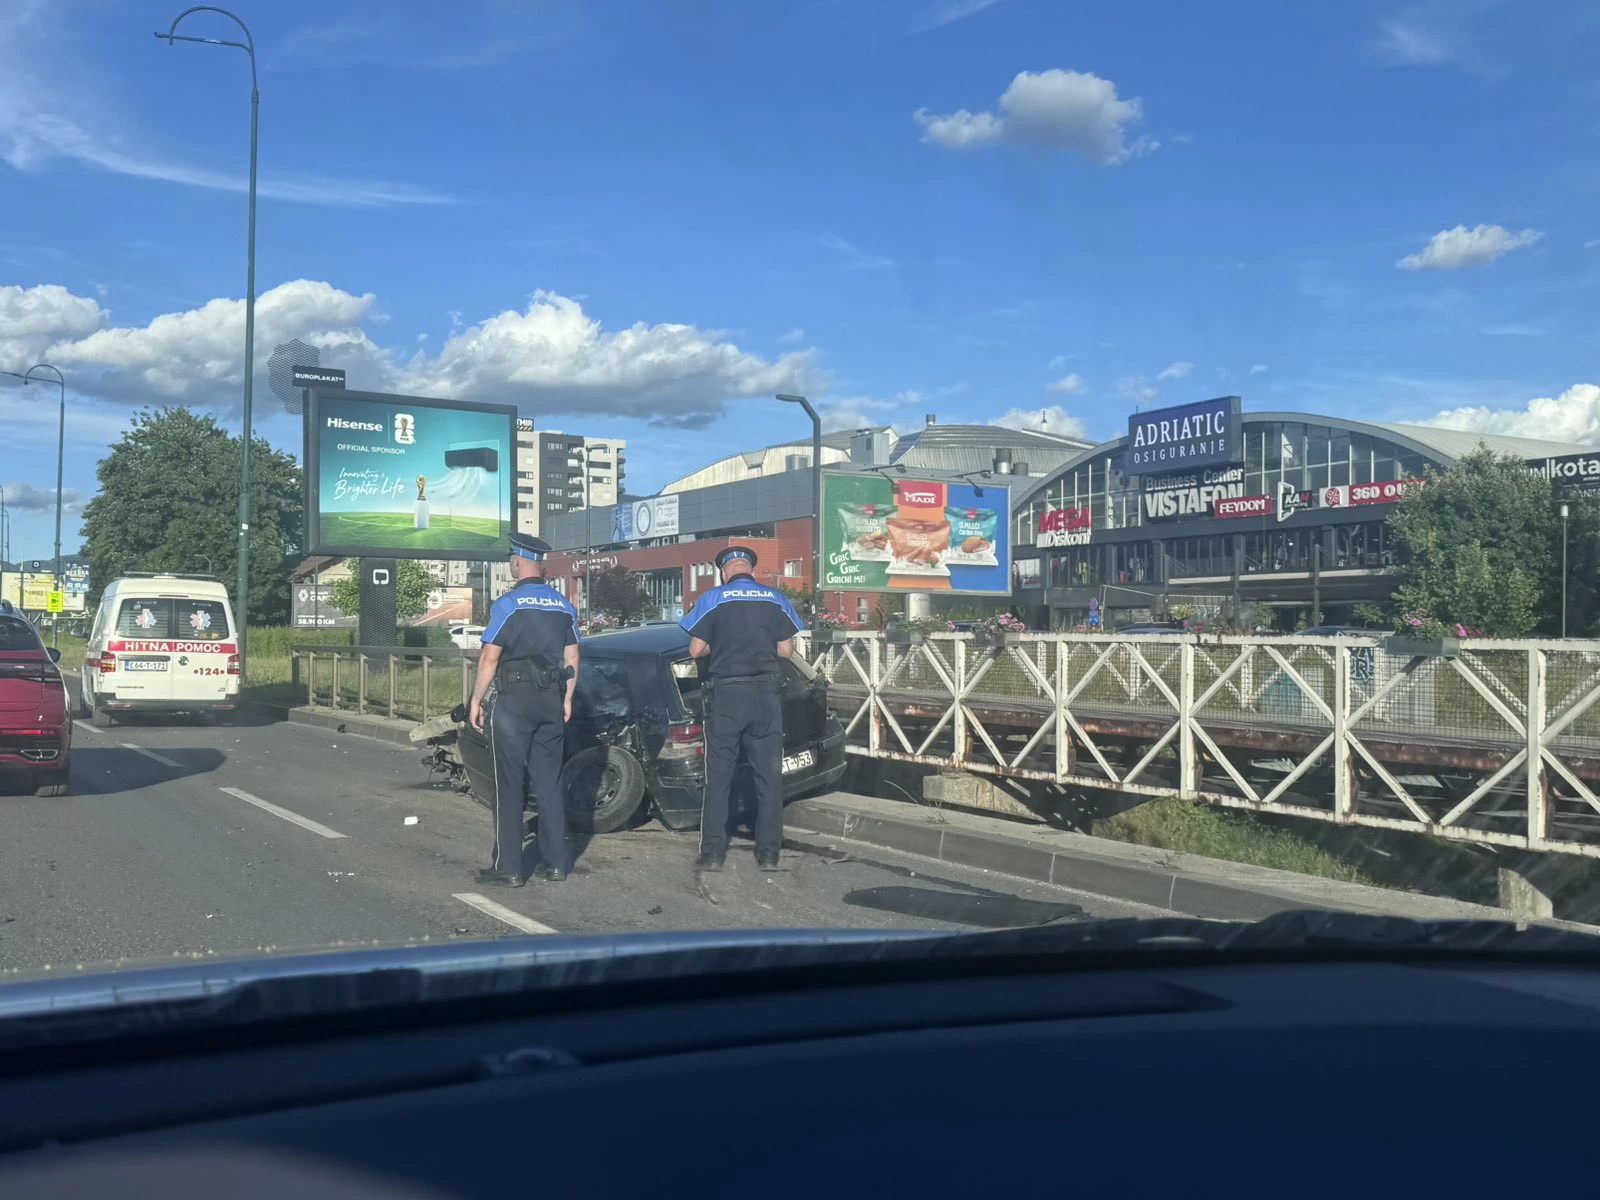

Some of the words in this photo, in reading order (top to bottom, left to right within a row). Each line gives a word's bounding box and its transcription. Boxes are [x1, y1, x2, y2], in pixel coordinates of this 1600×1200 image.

[327, 417, 383, 432] Hisense
[1134, 411, 1224, 447] ADRIATIC
[337, 443, 370, 453] OFFICIAL
[371, 446, 406, 455] SPONSOR
[1134, 439, 1224, 464] OSIGURANJE
[1146, 473, 1198, 491] Business
[1203, 466, 1244, 484] Center
[333, 479, 379, 501] Brighter
[380, 476, 406, 499] Life
[1352, 486, 1380, 500] 360
[1145, 483, 1244, 518] VISTAFON
[1219, 499, 1265, 514] FEYDOM
[723, 590, 775, 599] POLICIJA
[516, 596, 566, 609] POLICIJA
[125, 642, 169, 652] HITNA
[176, 643, 221, 653] POMOC
